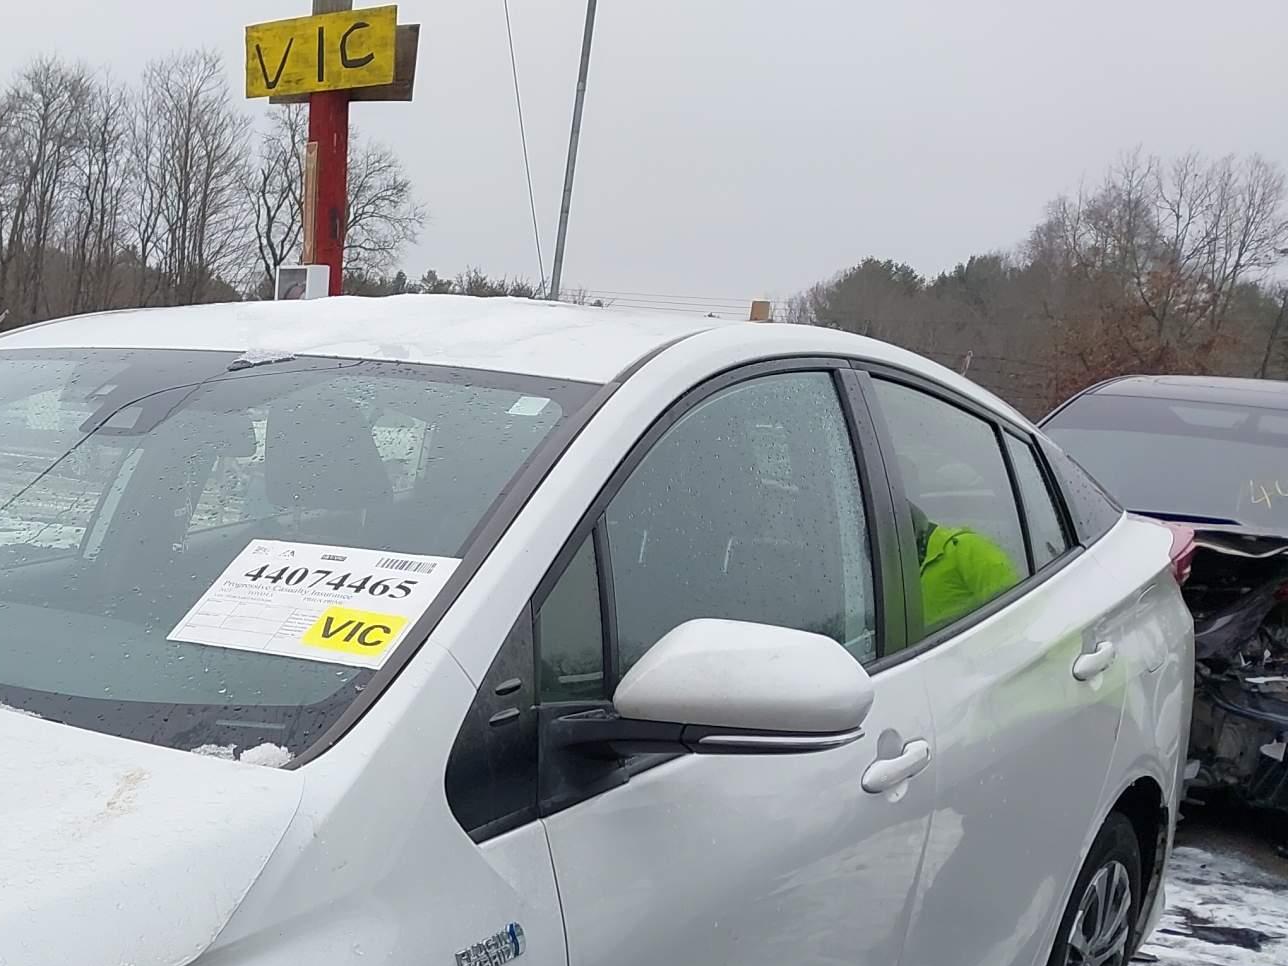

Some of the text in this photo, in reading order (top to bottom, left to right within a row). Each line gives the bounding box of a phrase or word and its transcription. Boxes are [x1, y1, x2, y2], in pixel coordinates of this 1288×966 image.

[255, 21, 375, 90] VIC
[223, 580, 272, 592] Progressive
[272, 585, 310, 597] Casualty
[244, 563, 419, 600] 44074465
[321, 616, 392, 647] VIC
